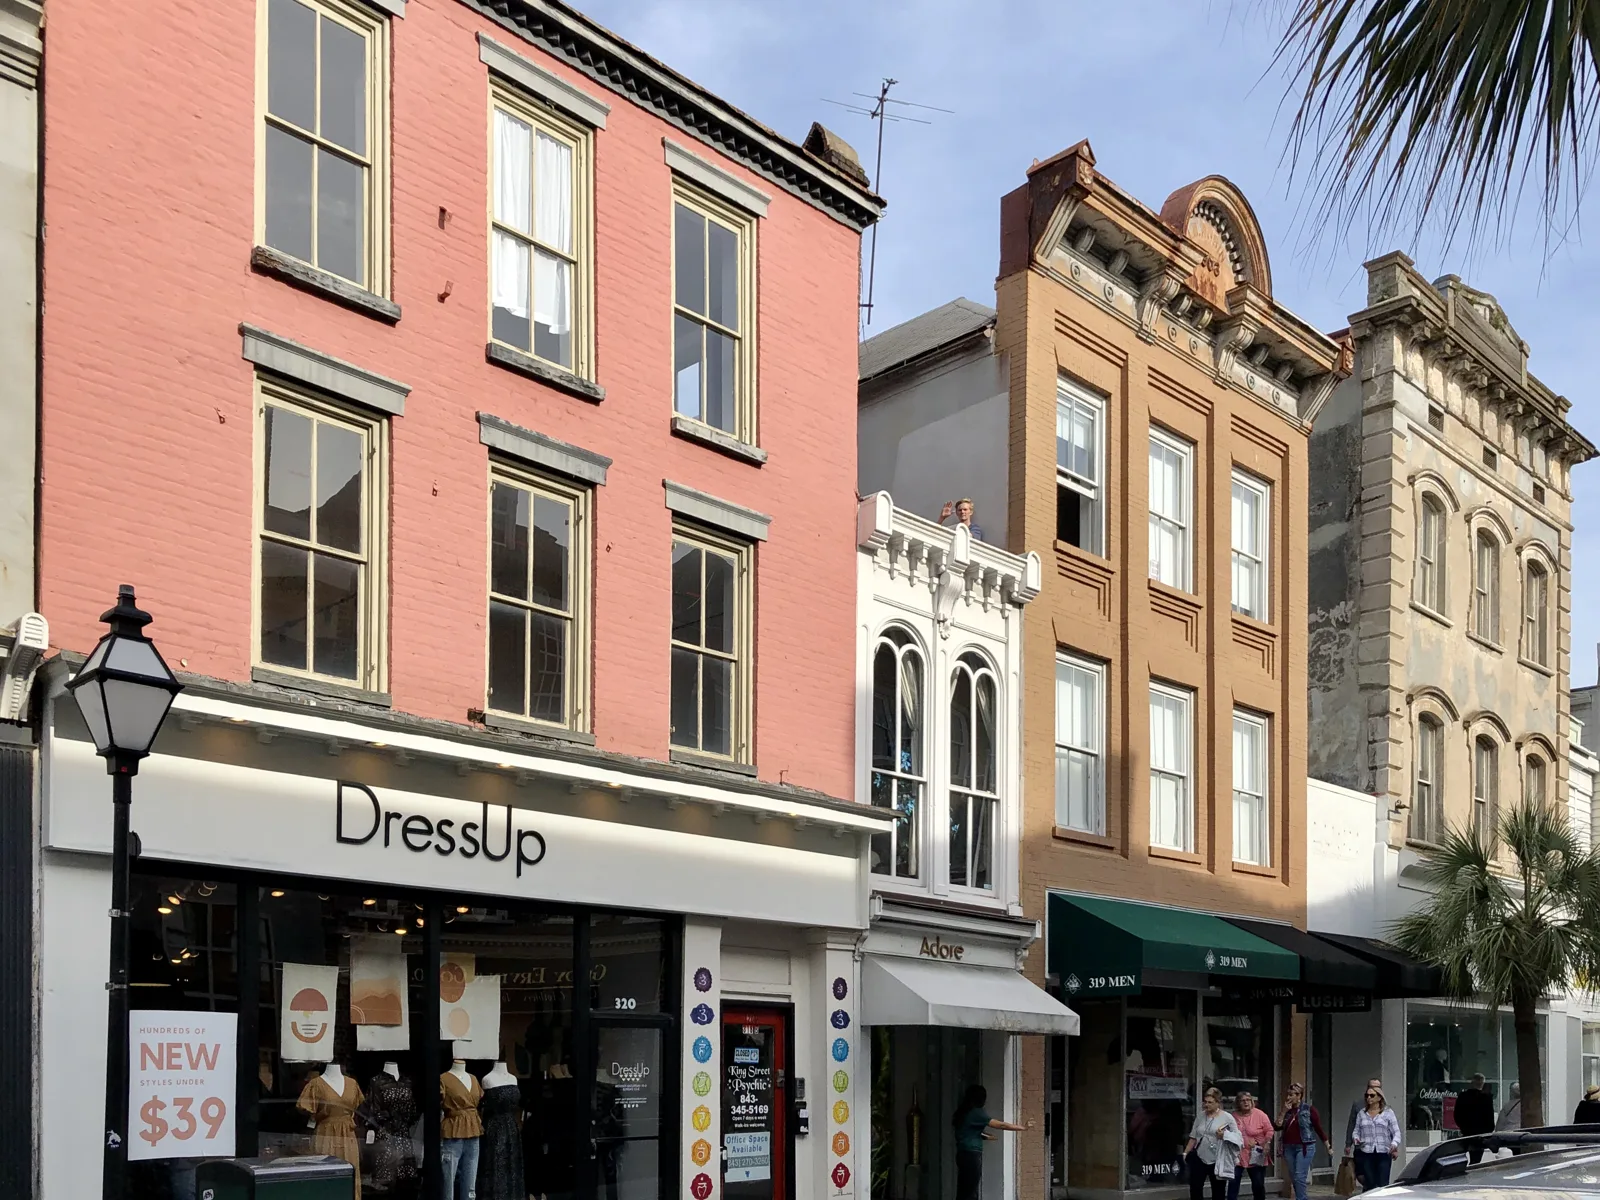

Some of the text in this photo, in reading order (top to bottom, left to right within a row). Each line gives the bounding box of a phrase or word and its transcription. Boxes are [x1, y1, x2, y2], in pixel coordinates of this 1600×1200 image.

[336, 779, 546, 878] DressUp
[919, 936, 964, 960] Adore
[1219, 956, 1247, 968] 319 MEN
[1088, 975, 1136, 989] 319 MEN
[1268, 986, 1294, 998] MEN
[615, 998, 636, 1010] 320
[1302, 995, 1344, 1009] LUSH
[139, 1027, 207, 1035] HUNDREDS OF
[140, 1042, 221, 1071] NEW
[735, 1049, 750, 1057] CLOSED
[611, 1061, 650, 1078] DressUp
[728, 1065, 771, 1079] King Street
[140, 1078, 205, 1087] STYLES UNDER
[731, 1078, 767, 1095] Psychic
[1131, 1079, 1147, 1092] KW
[740, 1094, 759, 1104] 843-
[730, 1105, 769, 1115] 345-5169
[139, 1095, 226, 1147] $39
[726, 1134, 769, 1144] Office Space
[731, 1144, 763, 1154] Available
[1141, 1163, 1171, 1175] 319 MEN
